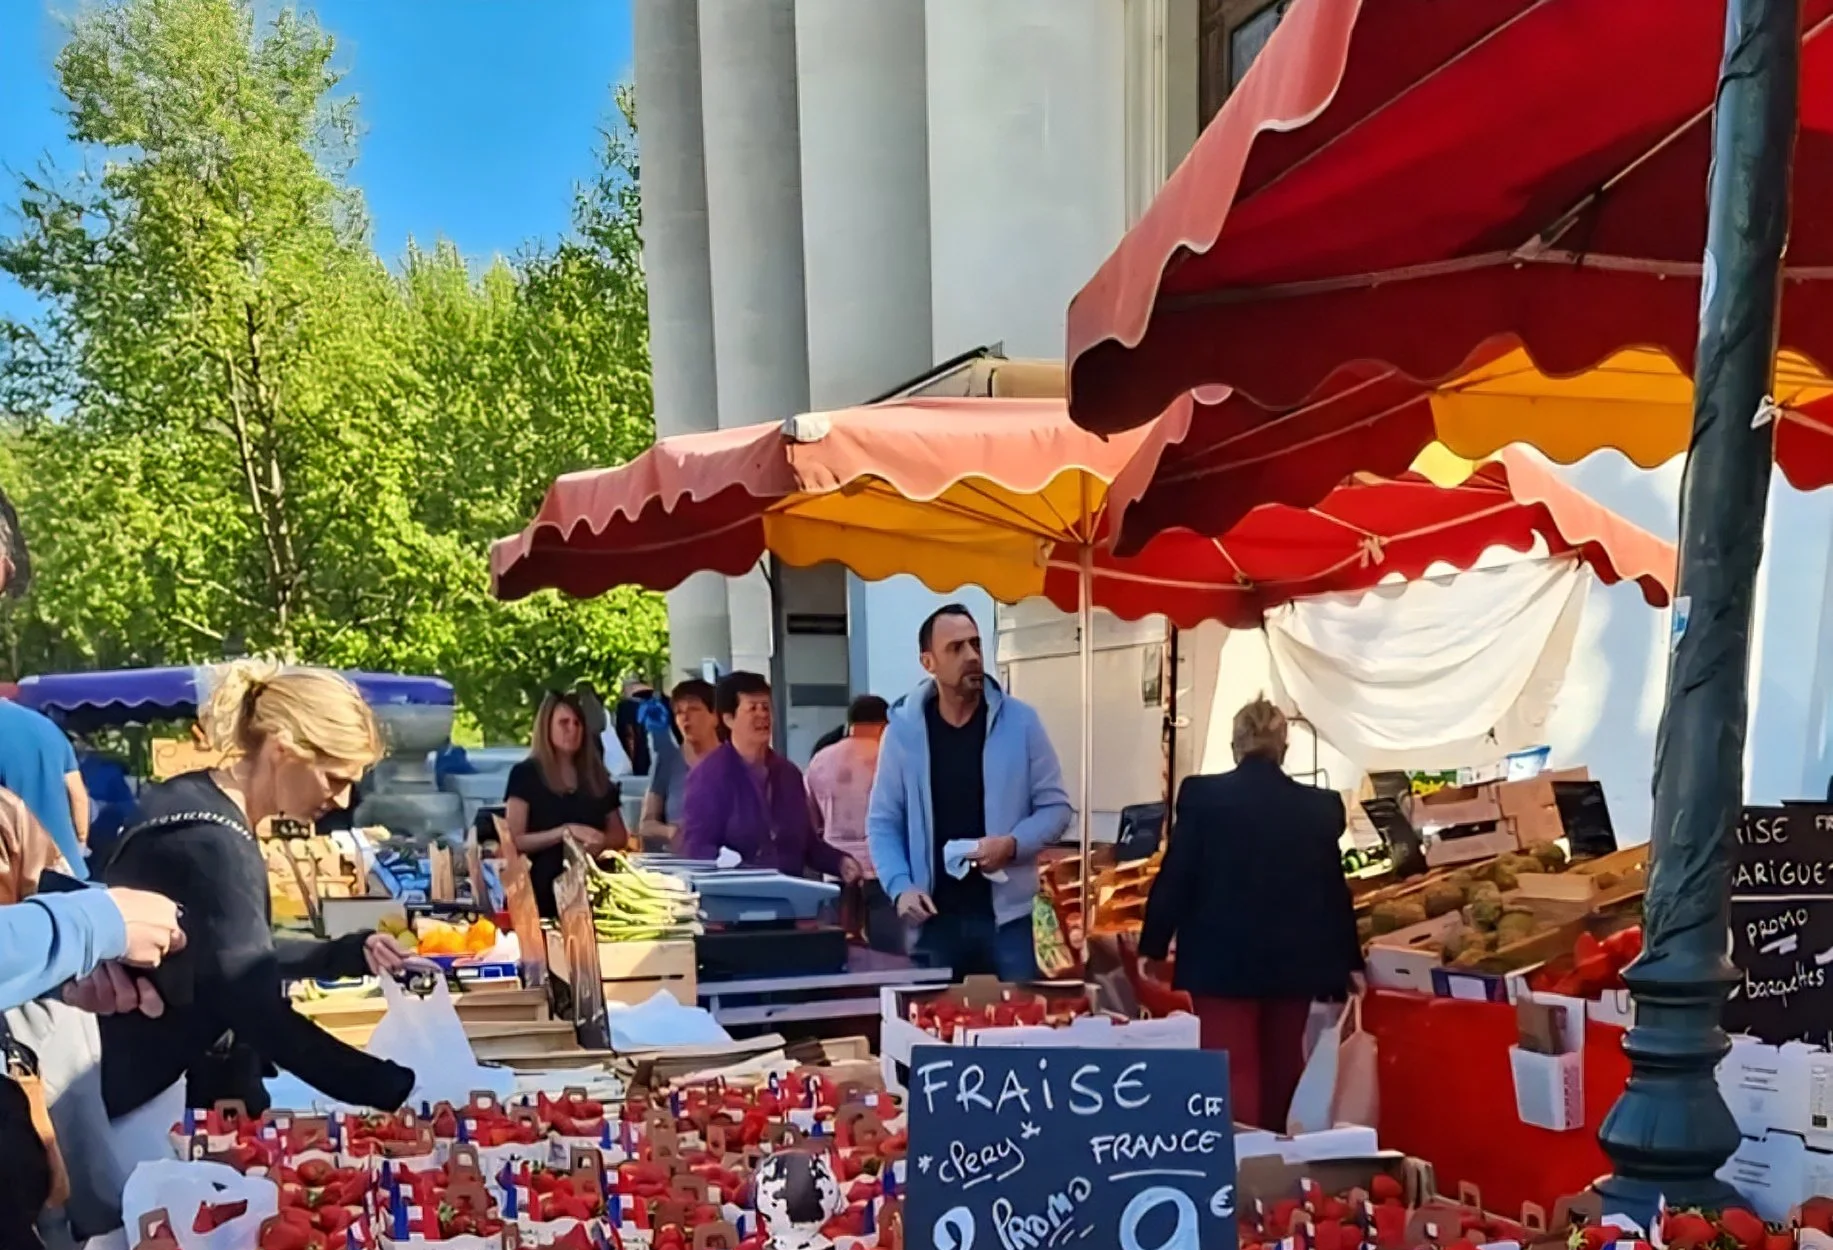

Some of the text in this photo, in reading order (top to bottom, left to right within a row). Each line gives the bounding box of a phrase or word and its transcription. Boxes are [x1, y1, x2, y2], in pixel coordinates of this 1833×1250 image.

[1747, 908, 1809, 947] PROMO
[1090, 1129, 1223, 1165] FRANCE
[1210, 1184, 1235, 1219] €
